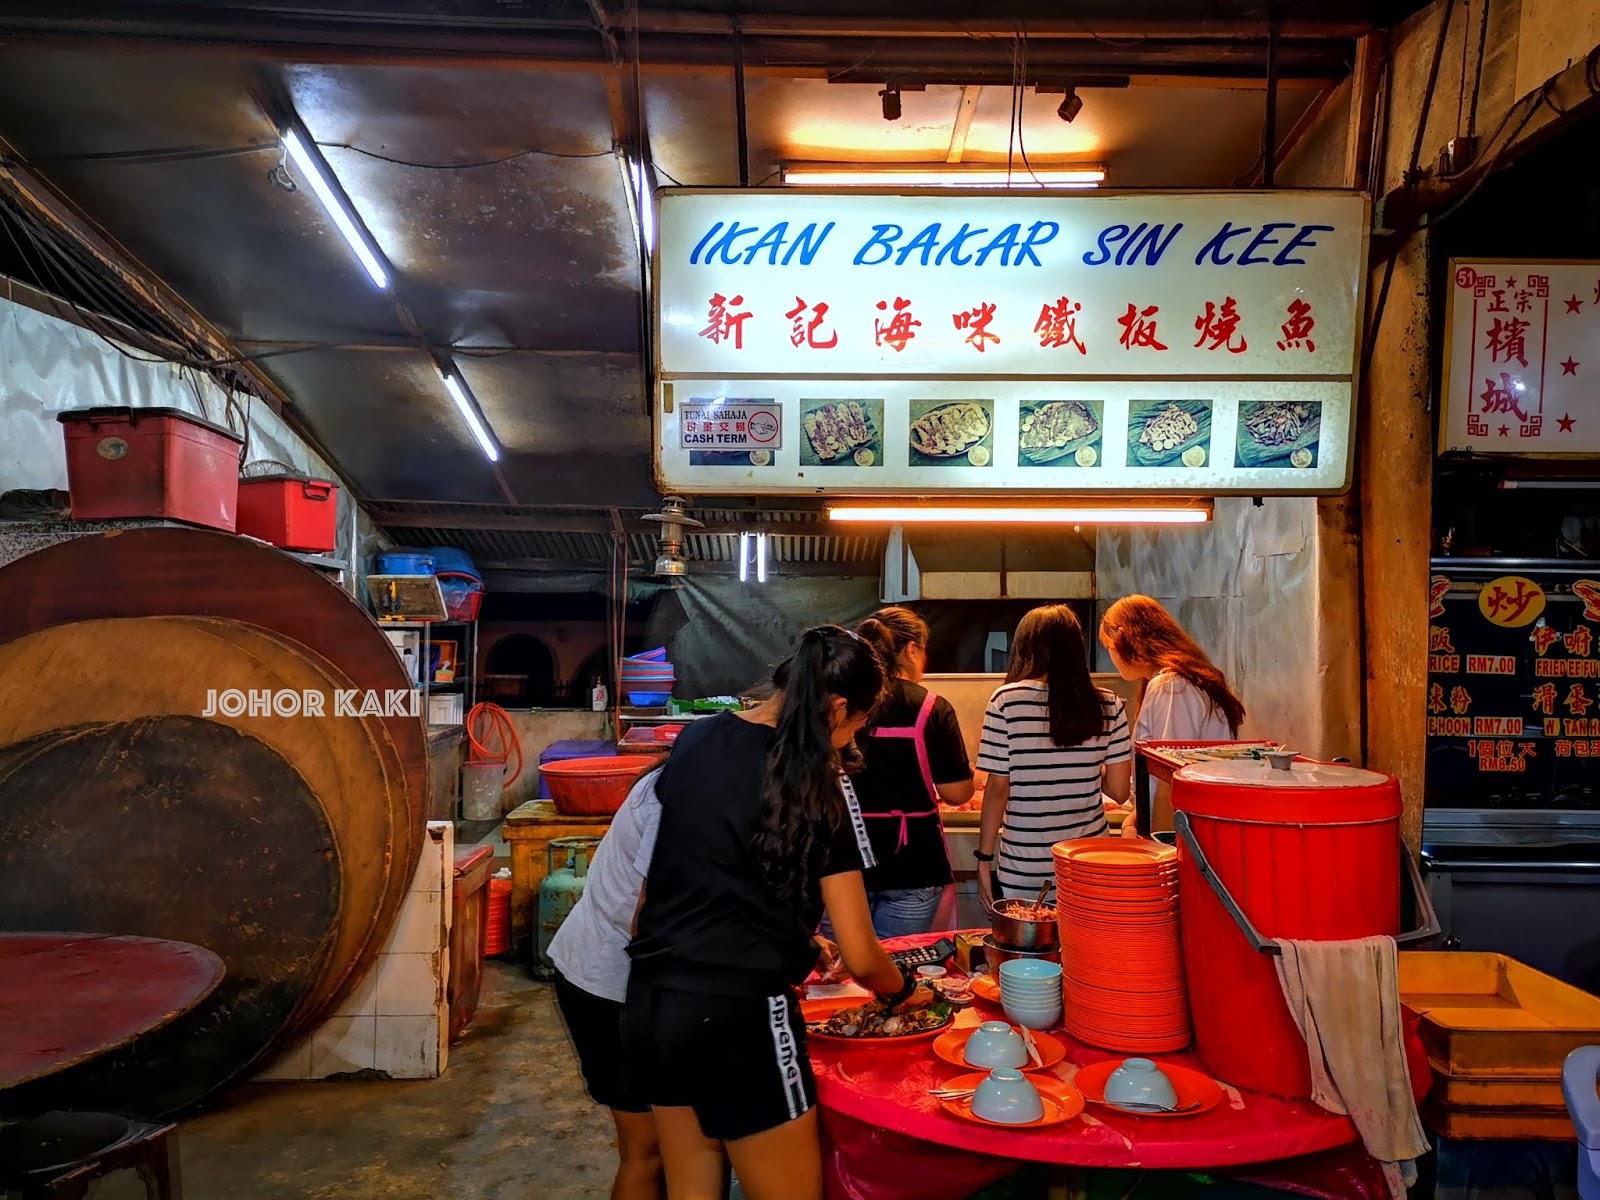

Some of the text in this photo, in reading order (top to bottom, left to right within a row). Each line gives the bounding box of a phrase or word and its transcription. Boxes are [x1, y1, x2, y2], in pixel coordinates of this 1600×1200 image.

[690, 221, 1335, 267] IKAN BAKAR SIN KEE
[1457, 270, 1475, 285] 51
[1487, 289, 1534, 313] 正宗
[698, 292, 1316, 355] 新記海咪鐵板燒魚
[1481, 316, 1531, 423] 檳城
[684, 410, 748, 420] TUNAI SAHAJA
[684, 434, 747, 443] CASH TERM
[1487, 581, 1540, 622] 炒
[1430, 655, 1514, 673] RICE RM7.00
[1536, 659, 1566, 676] FRIED
[1568, 660, 1582, 677] EE
[1583, 660, 1597, 677] FU
[1475, 718, 1522, 735] RM7.00
[1564, 718, 1587, 736] TAN
[1479, 756, 1525, 771] RM8.50
